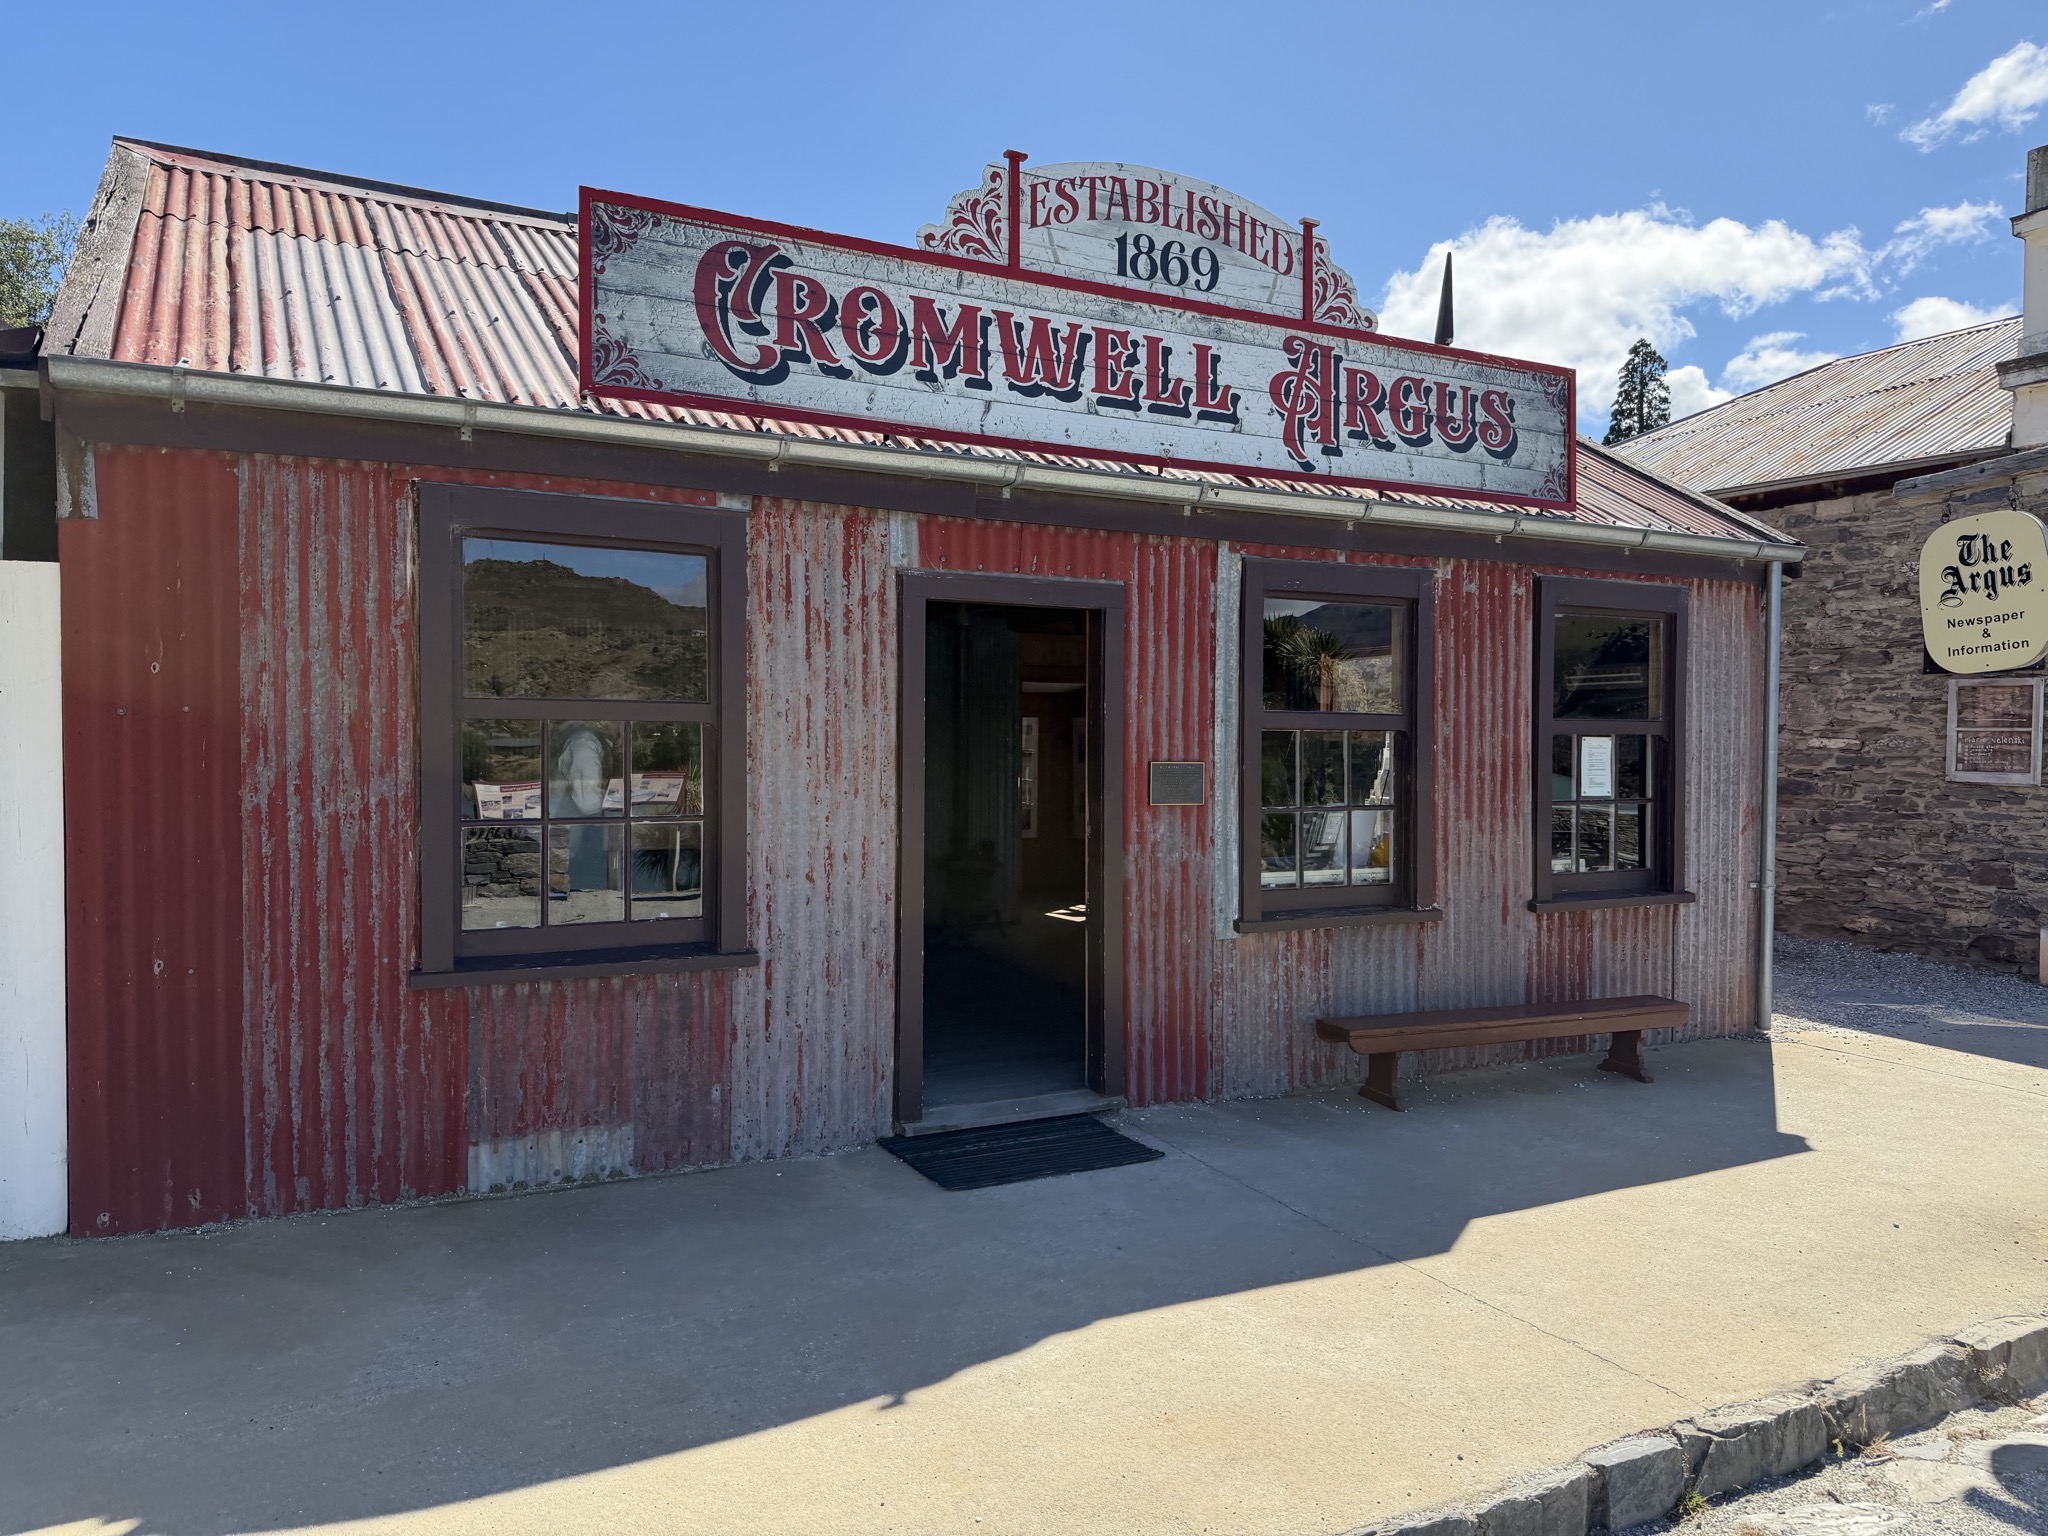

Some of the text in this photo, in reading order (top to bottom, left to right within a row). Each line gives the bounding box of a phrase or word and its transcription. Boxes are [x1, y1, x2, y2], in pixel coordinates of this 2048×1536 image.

[1028, 174, 1294, 277] ESTABLISHED
[1113, 230, 1221, 293] 1869
[691, 239, 1519, 473] CROMWELL ARGUS
[1956, 532, 2014, 568] The
[1937, 561, 2034, 611] Argus
[1946, 610, 2026, 629] Newspaper
[1981, 627, 1992, 639] &
[1947, 639, 2030, 657] Information
